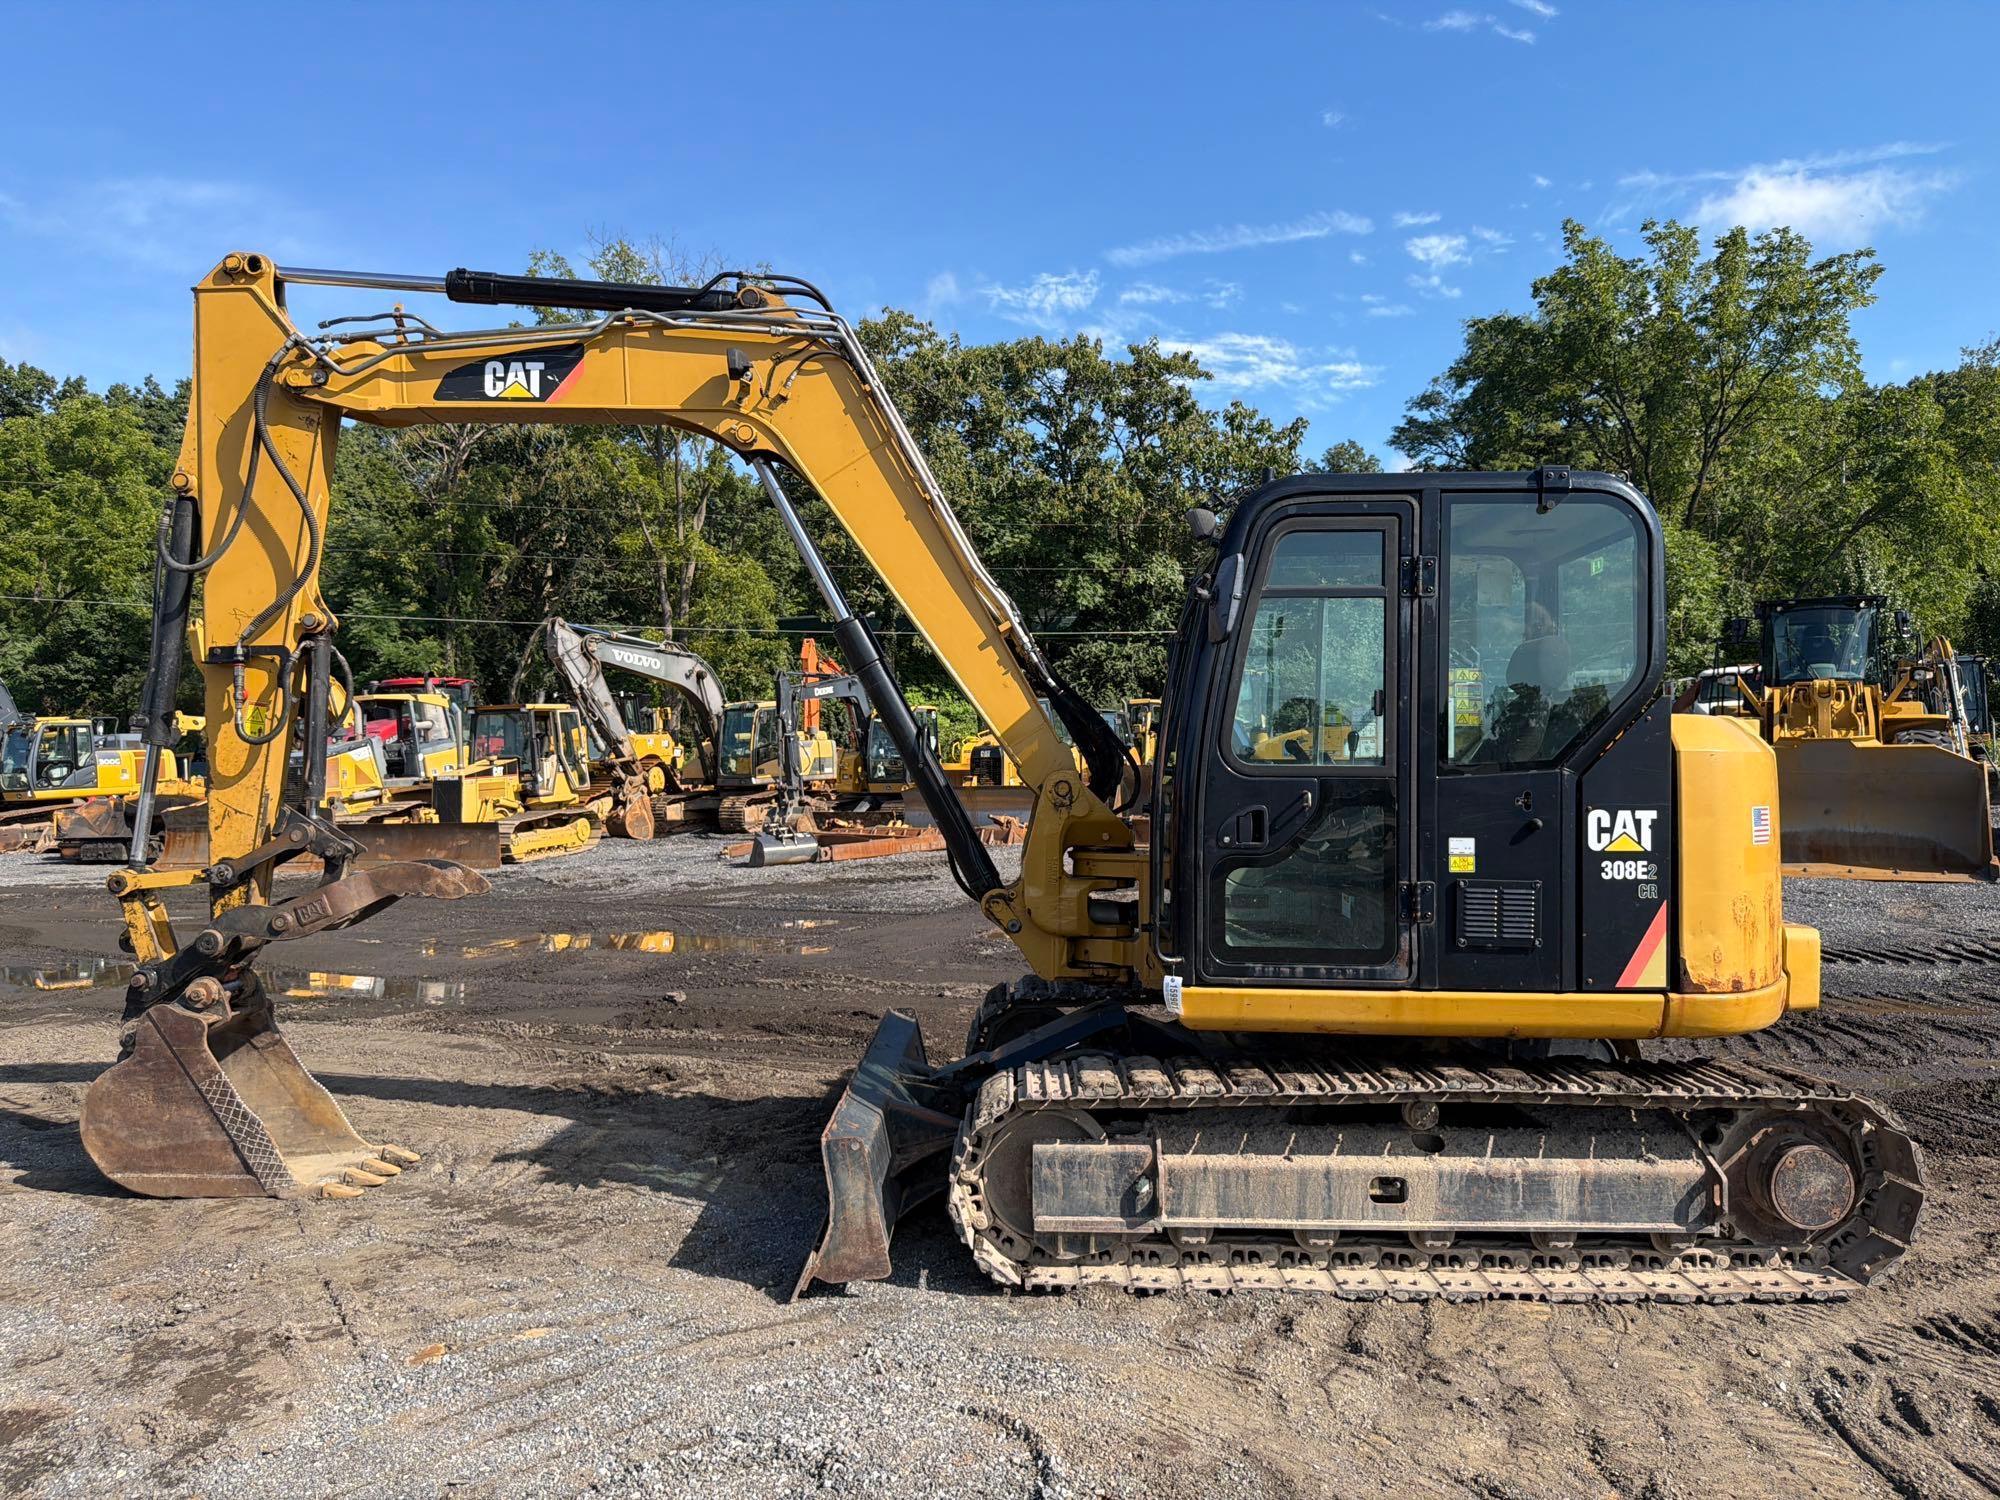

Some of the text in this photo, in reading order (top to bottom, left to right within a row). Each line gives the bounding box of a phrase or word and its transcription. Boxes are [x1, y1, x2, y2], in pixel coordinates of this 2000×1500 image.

[484, 361, 545, 398] CAT
[612, 648, 661, 670] VOLVO
[814, 686, 834, 696] DEERE
[1587, 809, 1658, 852] CAT
[1638, 883, 1658, 899] CR
[297, 898, 325, 923] CAT
